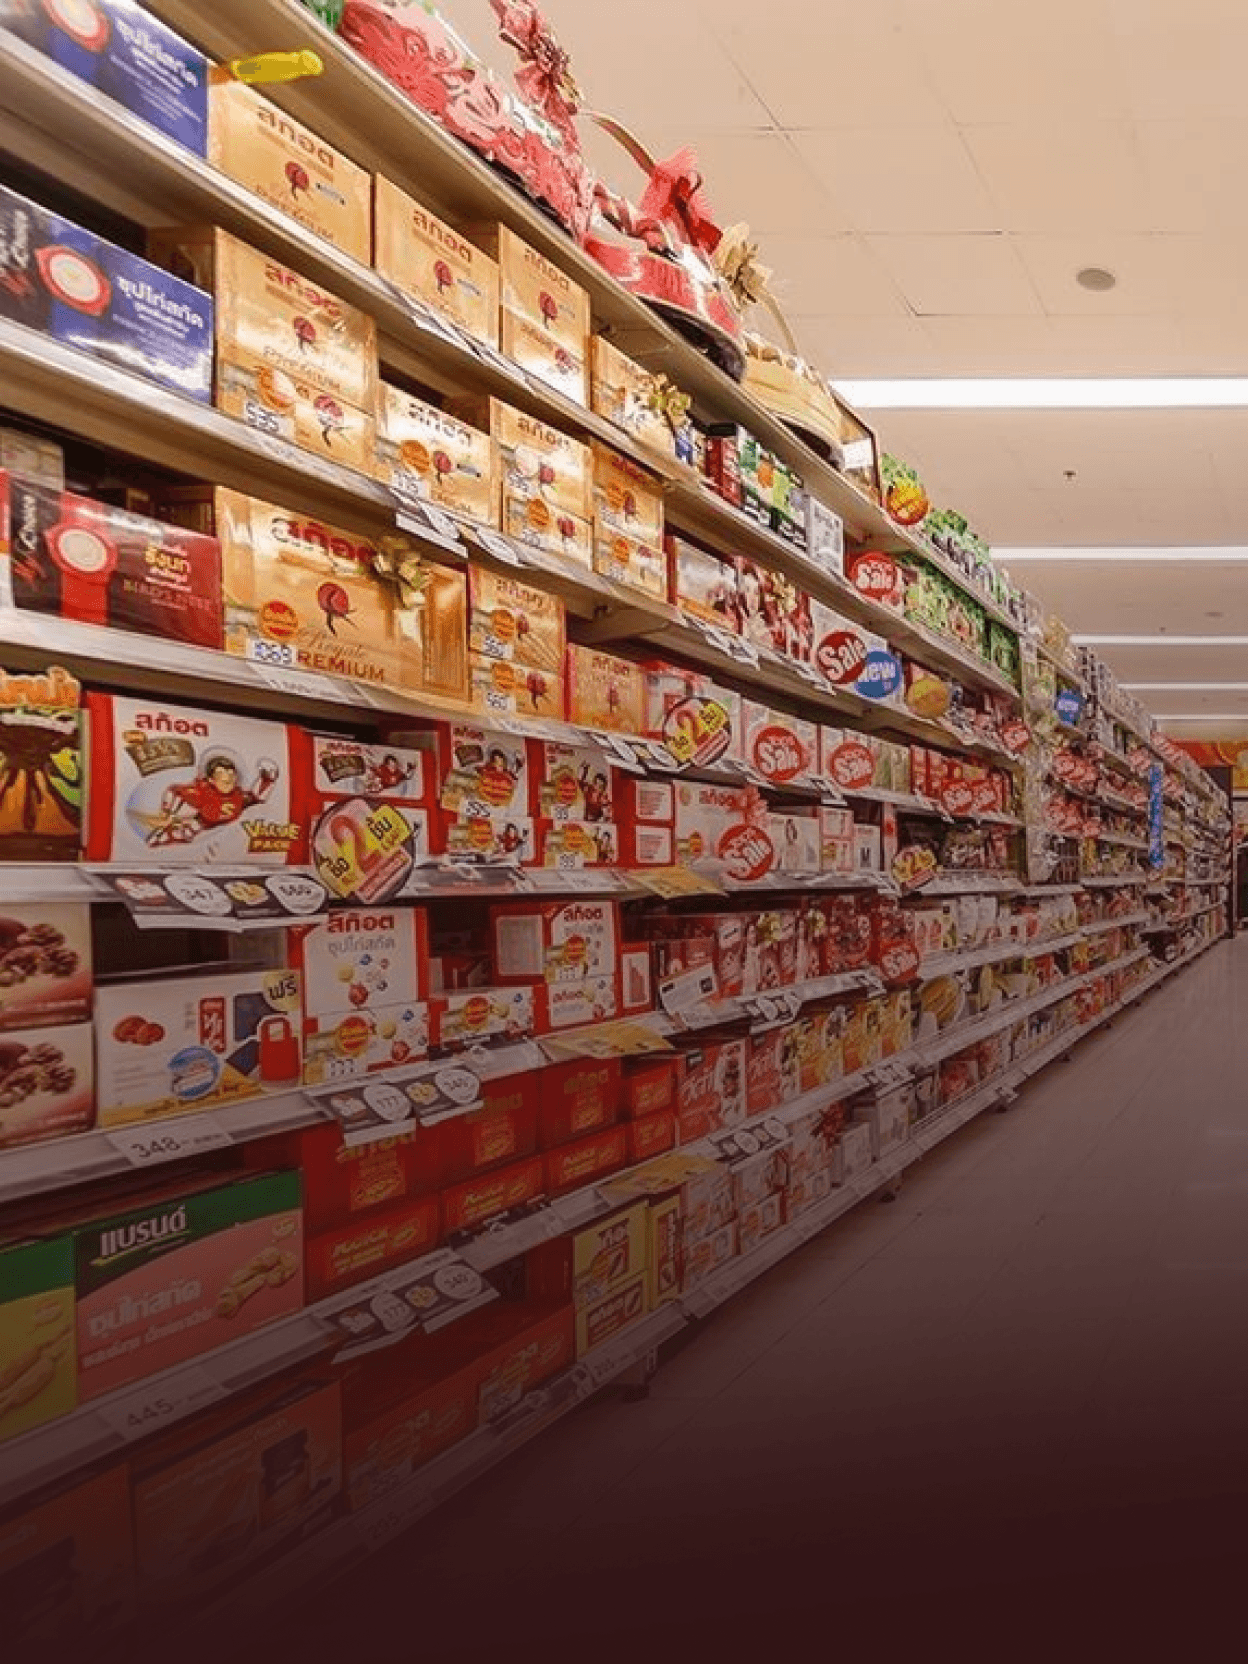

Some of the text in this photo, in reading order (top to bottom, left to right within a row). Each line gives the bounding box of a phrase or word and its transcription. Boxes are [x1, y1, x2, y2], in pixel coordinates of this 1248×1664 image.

[297, 650, 384, 682] REMIUM
[819, 638, 864, 681] Sale
[101, 1203, 187, 1258] แบรนด์
